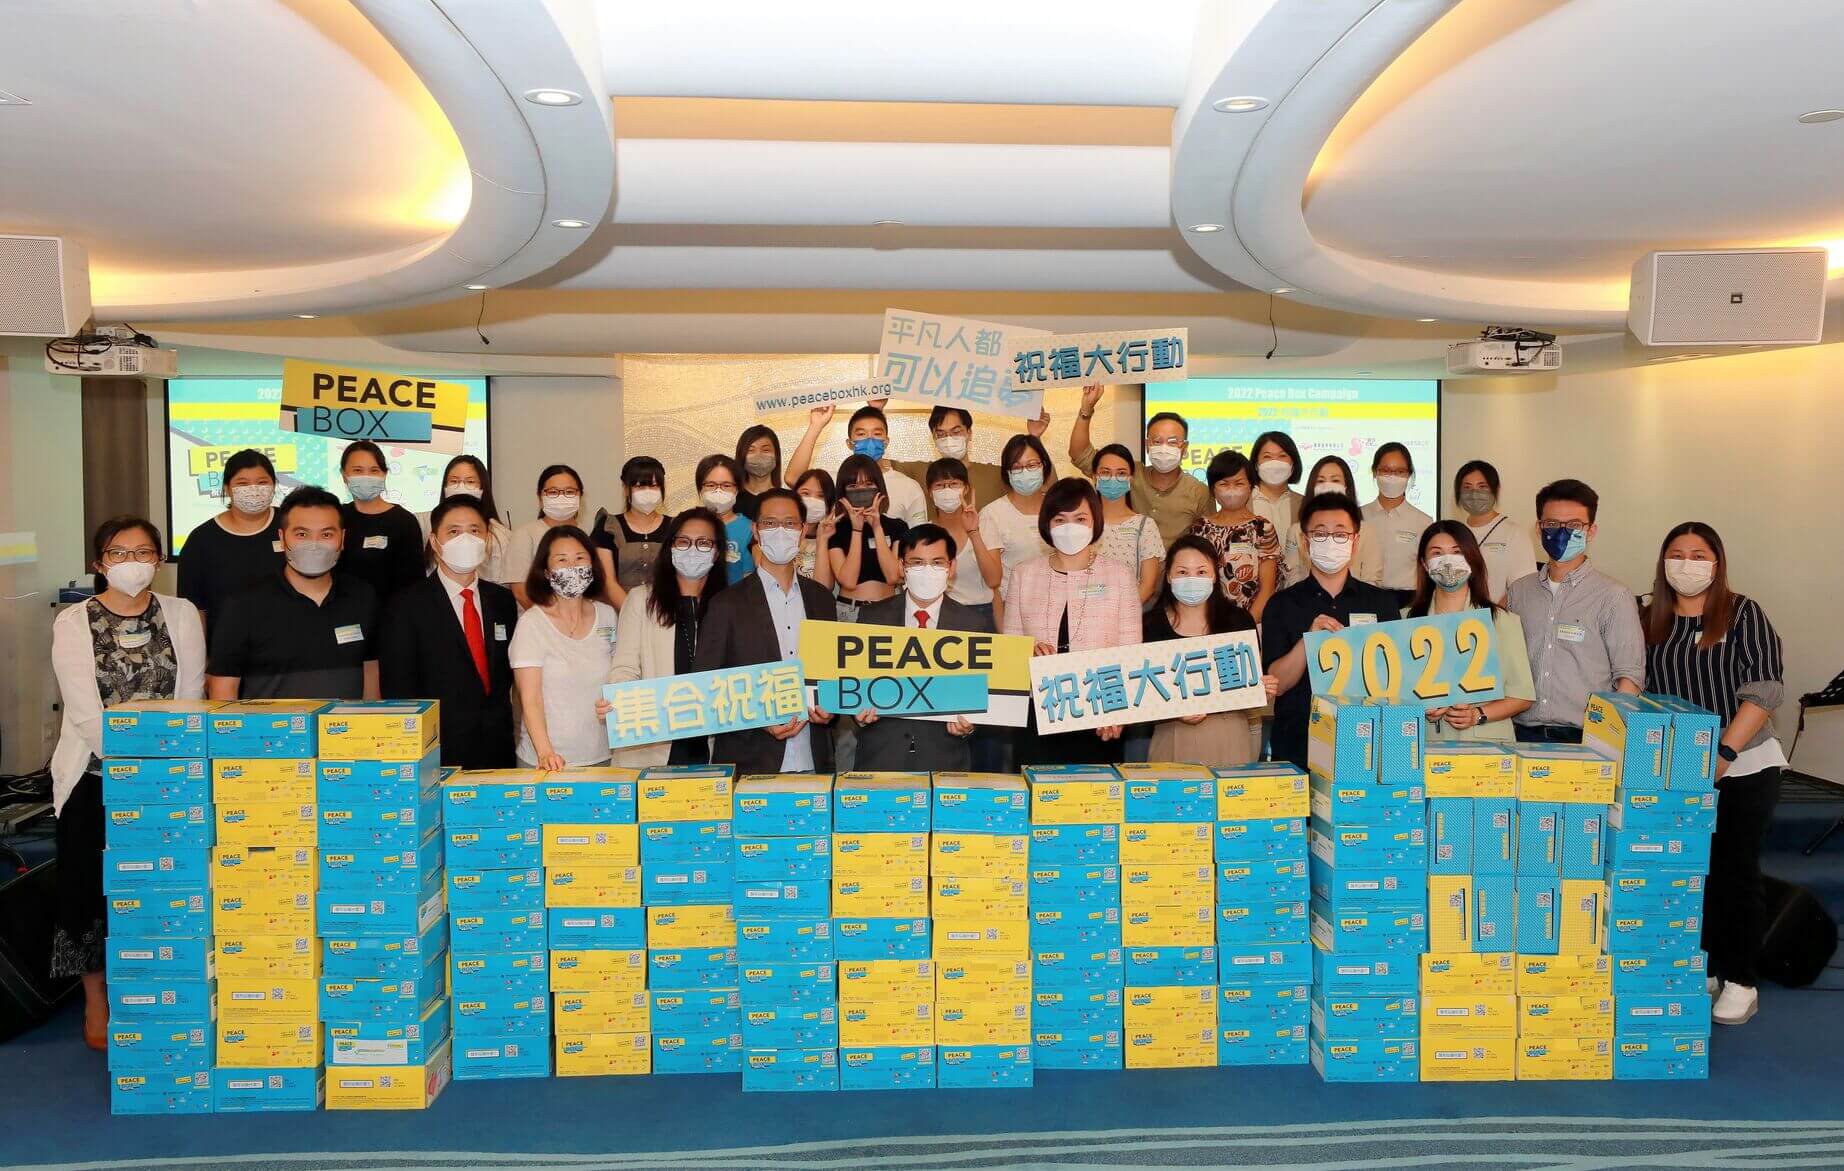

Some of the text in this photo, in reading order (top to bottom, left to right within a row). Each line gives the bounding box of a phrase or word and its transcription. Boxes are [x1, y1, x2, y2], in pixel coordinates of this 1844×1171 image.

[888, 316, 1002, 358] 平凡人都
[1014, 336, 1183, 384] 祝福大行動
[313, 373, 436, 409] PEACE
[756, 383, 891, 410] www.peaceboxhk.org
[314, 406, 389, 438] BOX
[837, 635, 993, 670] PEACE
[1318, 618, 1496, 702] 2022
[614, 665, 803, 738] 集合祝福
[839, 675, 935, 710] BOX
[1039, 641, 1258, 723] 祝福大行動
